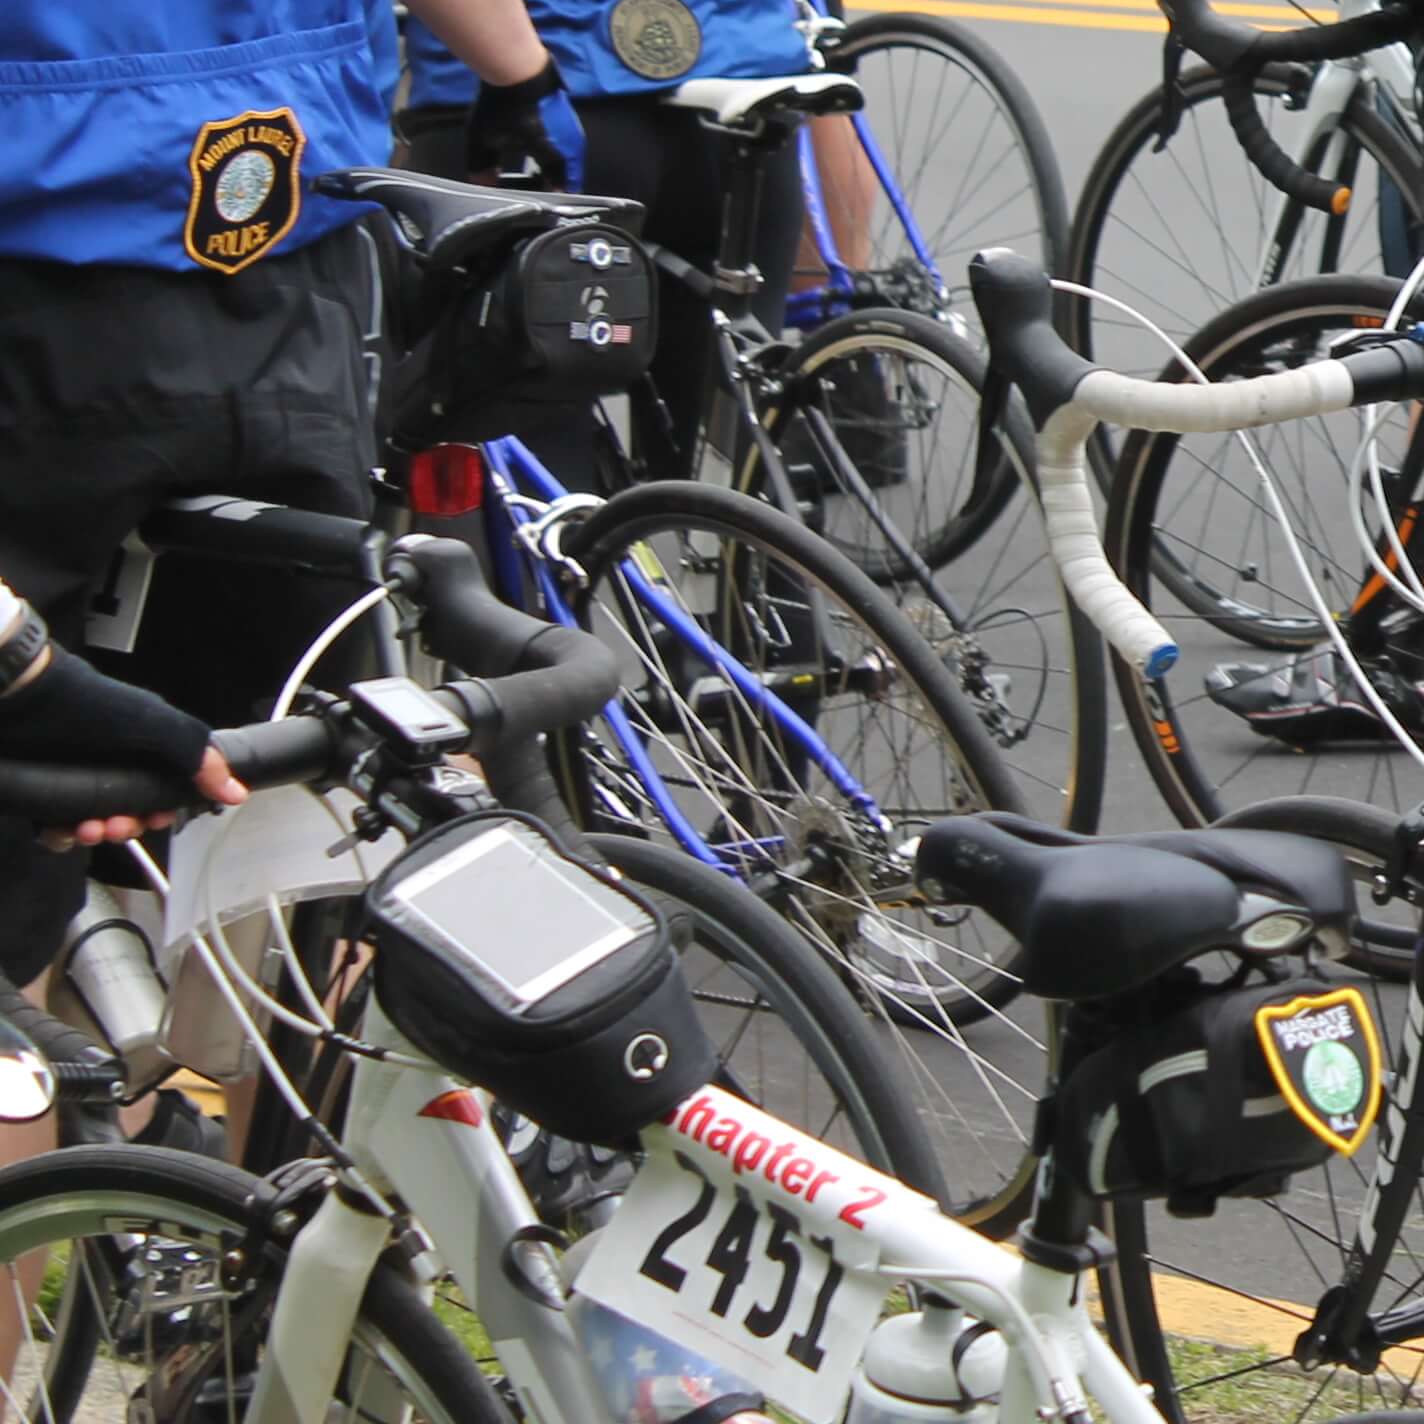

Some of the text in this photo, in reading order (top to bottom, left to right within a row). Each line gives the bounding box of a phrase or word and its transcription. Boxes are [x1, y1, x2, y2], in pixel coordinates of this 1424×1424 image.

[198, 127, 246, 172] MOUNT
[1282, 1024, 1356, 1052] POLICE
[838, 1185, 888, 1232] 2
[639, 1149, 846, 1375] 2451
